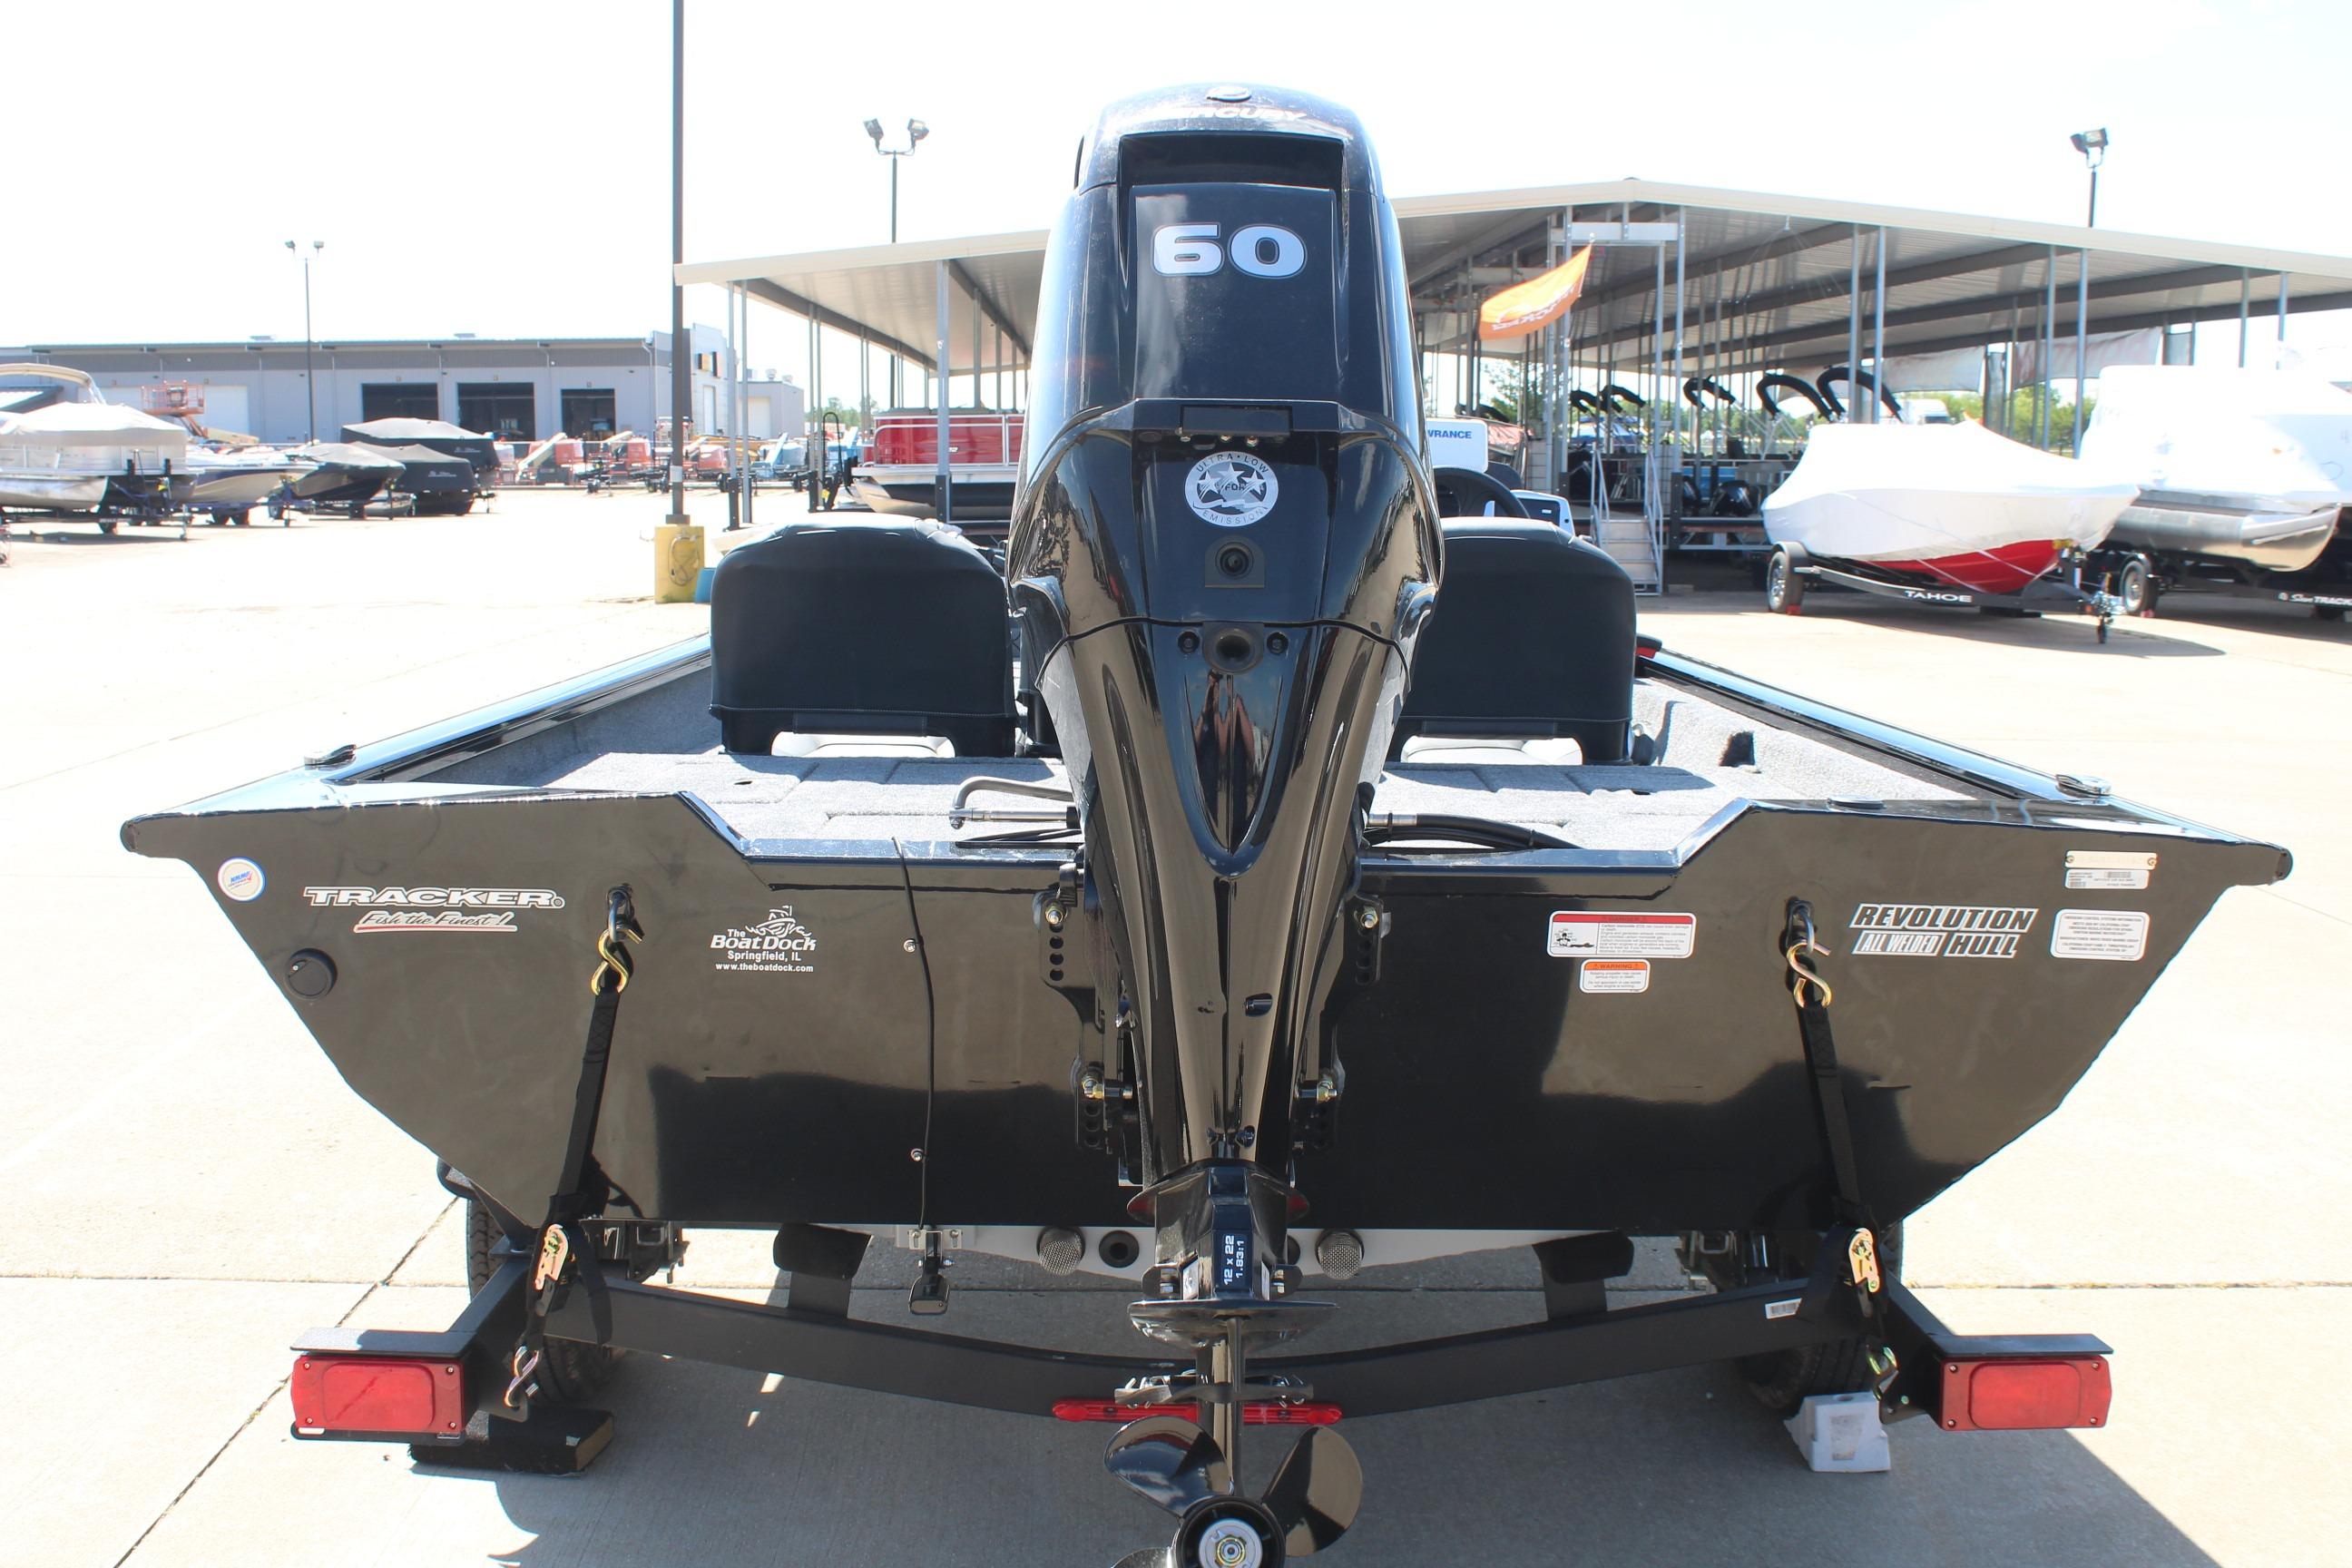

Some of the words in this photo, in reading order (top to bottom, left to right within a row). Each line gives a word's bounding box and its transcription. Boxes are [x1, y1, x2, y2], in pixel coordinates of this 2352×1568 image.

[1151, 222, 1308, 279] 60
[1427, 429, 1473, 439] WRANCE
[1196, 453, 1233, 473] ULTRA
[1244, 456, 1269, 474] LOW
[1202, 508, 1264, 524] EMISSION
[1905, 590, 1973, 603] TAHOE
[304, 887, 555, 907] TRACKER
[363, 913, 401, 926] Fish
[405, 913, 431, 925] the
[1850, 904, 2039, 933] REVOLUTION
[727, 928, 746, 937] The
[1863, 934, 1887, 951] ALL
[1887, 935, 1940, 952] WELDED
[1944, 933, 2020, 958] HULL
[727, 950, 789, 962] Springfield,
[791, 952, 801, 961] IL
[715, 963, 814, 972] www.theboatdock.com
[1225, 1235, 1234, 1254] 22
[1236, 1240, 1244, 1278] 1.83:1
[1224, 1269, 1232, 1285] 12
